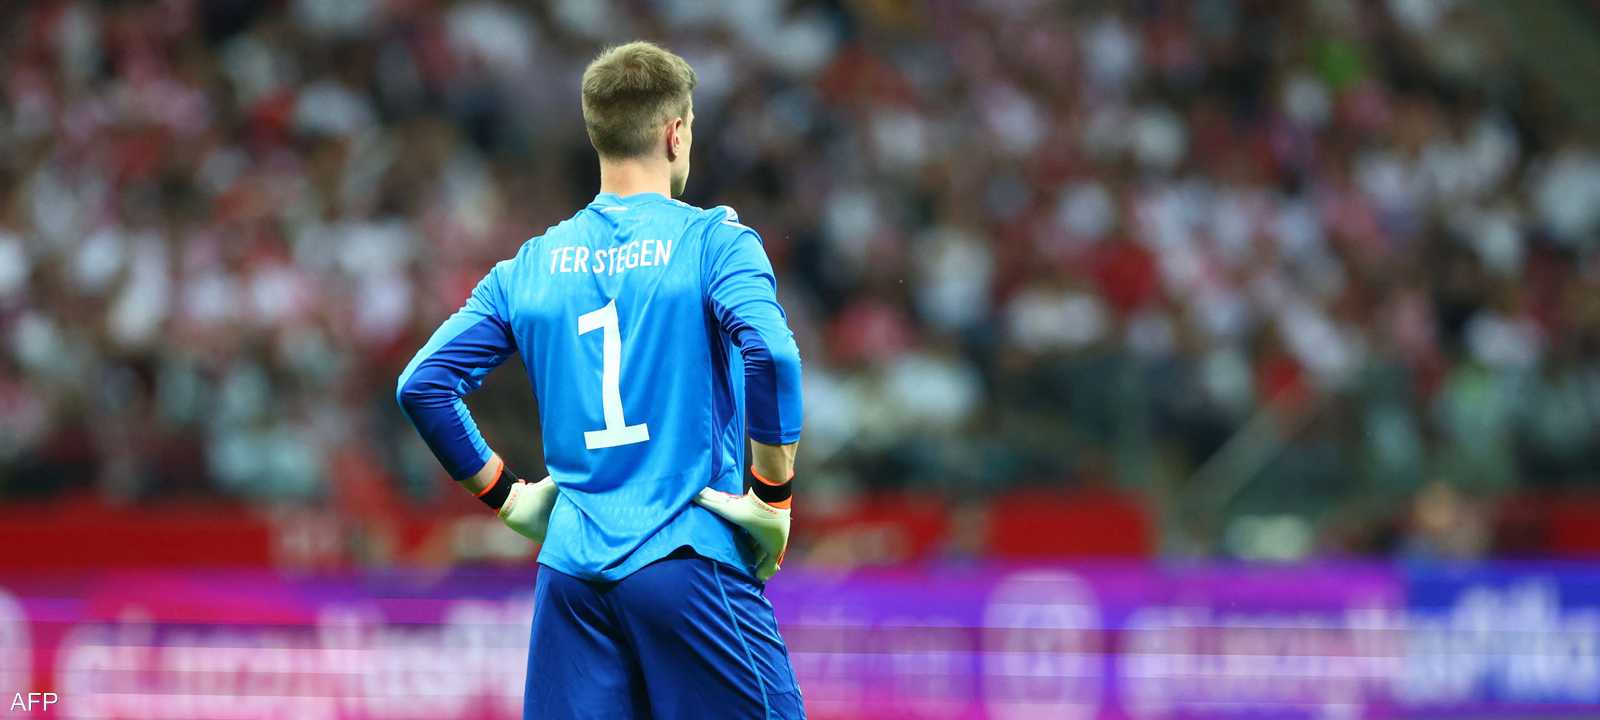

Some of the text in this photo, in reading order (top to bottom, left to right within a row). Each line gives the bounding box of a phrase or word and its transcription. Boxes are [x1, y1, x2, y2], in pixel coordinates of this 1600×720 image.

[550, 239, 672, 276] TER STEGEN
[578, 298, 650, 450] 1
